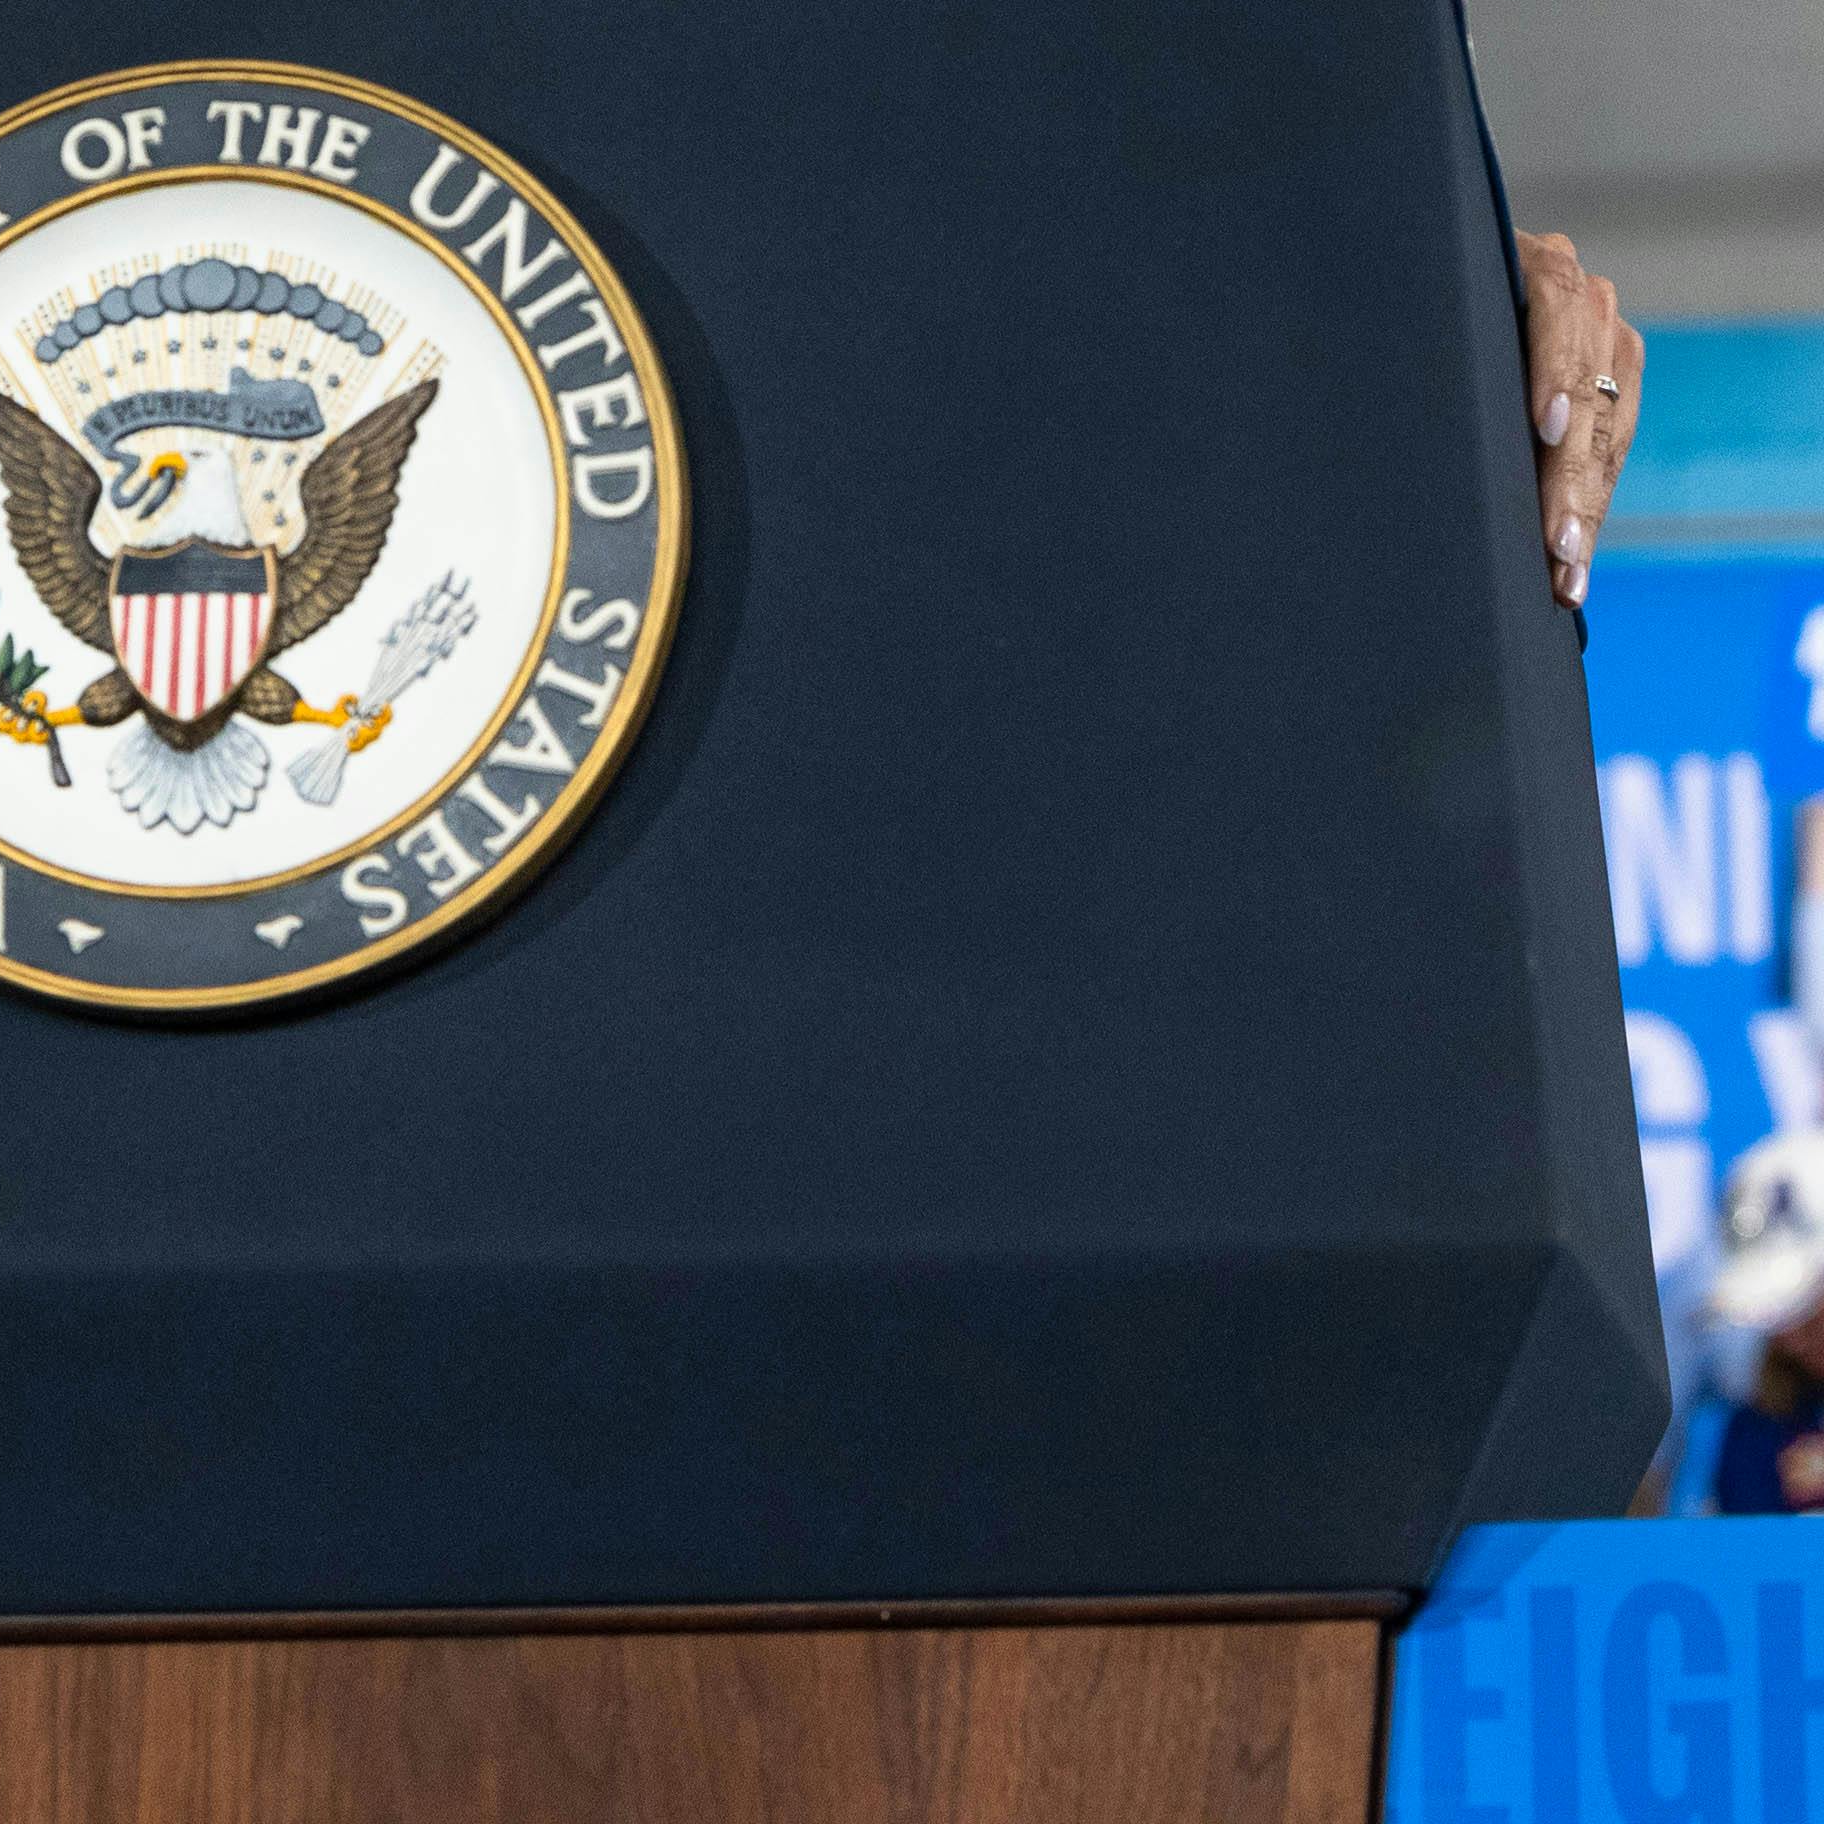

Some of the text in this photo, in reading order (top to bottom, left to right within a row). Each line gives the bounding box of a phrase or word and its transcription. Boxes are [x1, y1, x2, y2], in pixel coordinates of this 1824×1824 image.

[60, 107, 166, 181] OF
[206, 100, 371, 183] THE
[409, 144, 656, 519] UNITED
[340, 587, 642, 938] STATES
